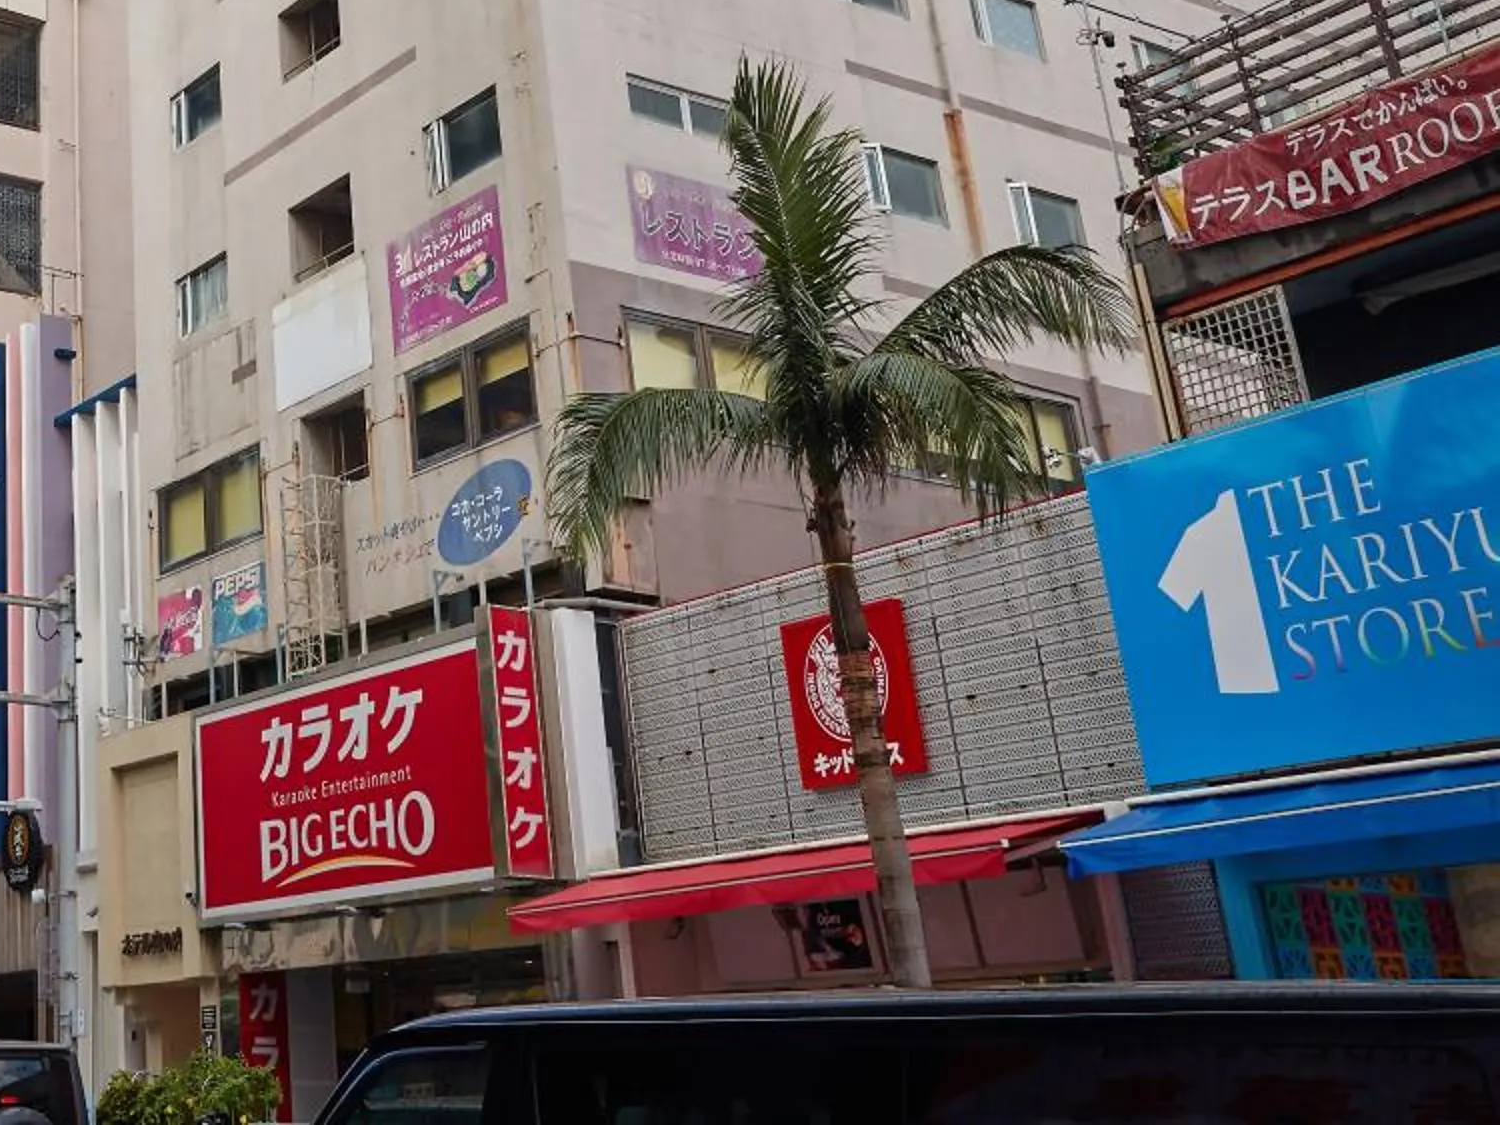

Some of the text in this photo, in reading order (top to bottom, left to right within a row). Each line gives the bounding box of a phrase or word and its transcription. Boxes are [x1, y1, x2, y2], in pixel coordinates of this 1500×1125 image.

[1247, 458, 1381, 538] THE
[1157, 488, 1280, 694] 1
[1285, 586, 1500, 680] STORE
[259, 685, 424, 783] カラオケ
[496, 628, 546, 851] カラオケ
[814, 742, 904, 778] キッドス
[271, 765, 413, 809] Karaoke Entertainment
[260, 790, 436, 882] BIG ECHO
